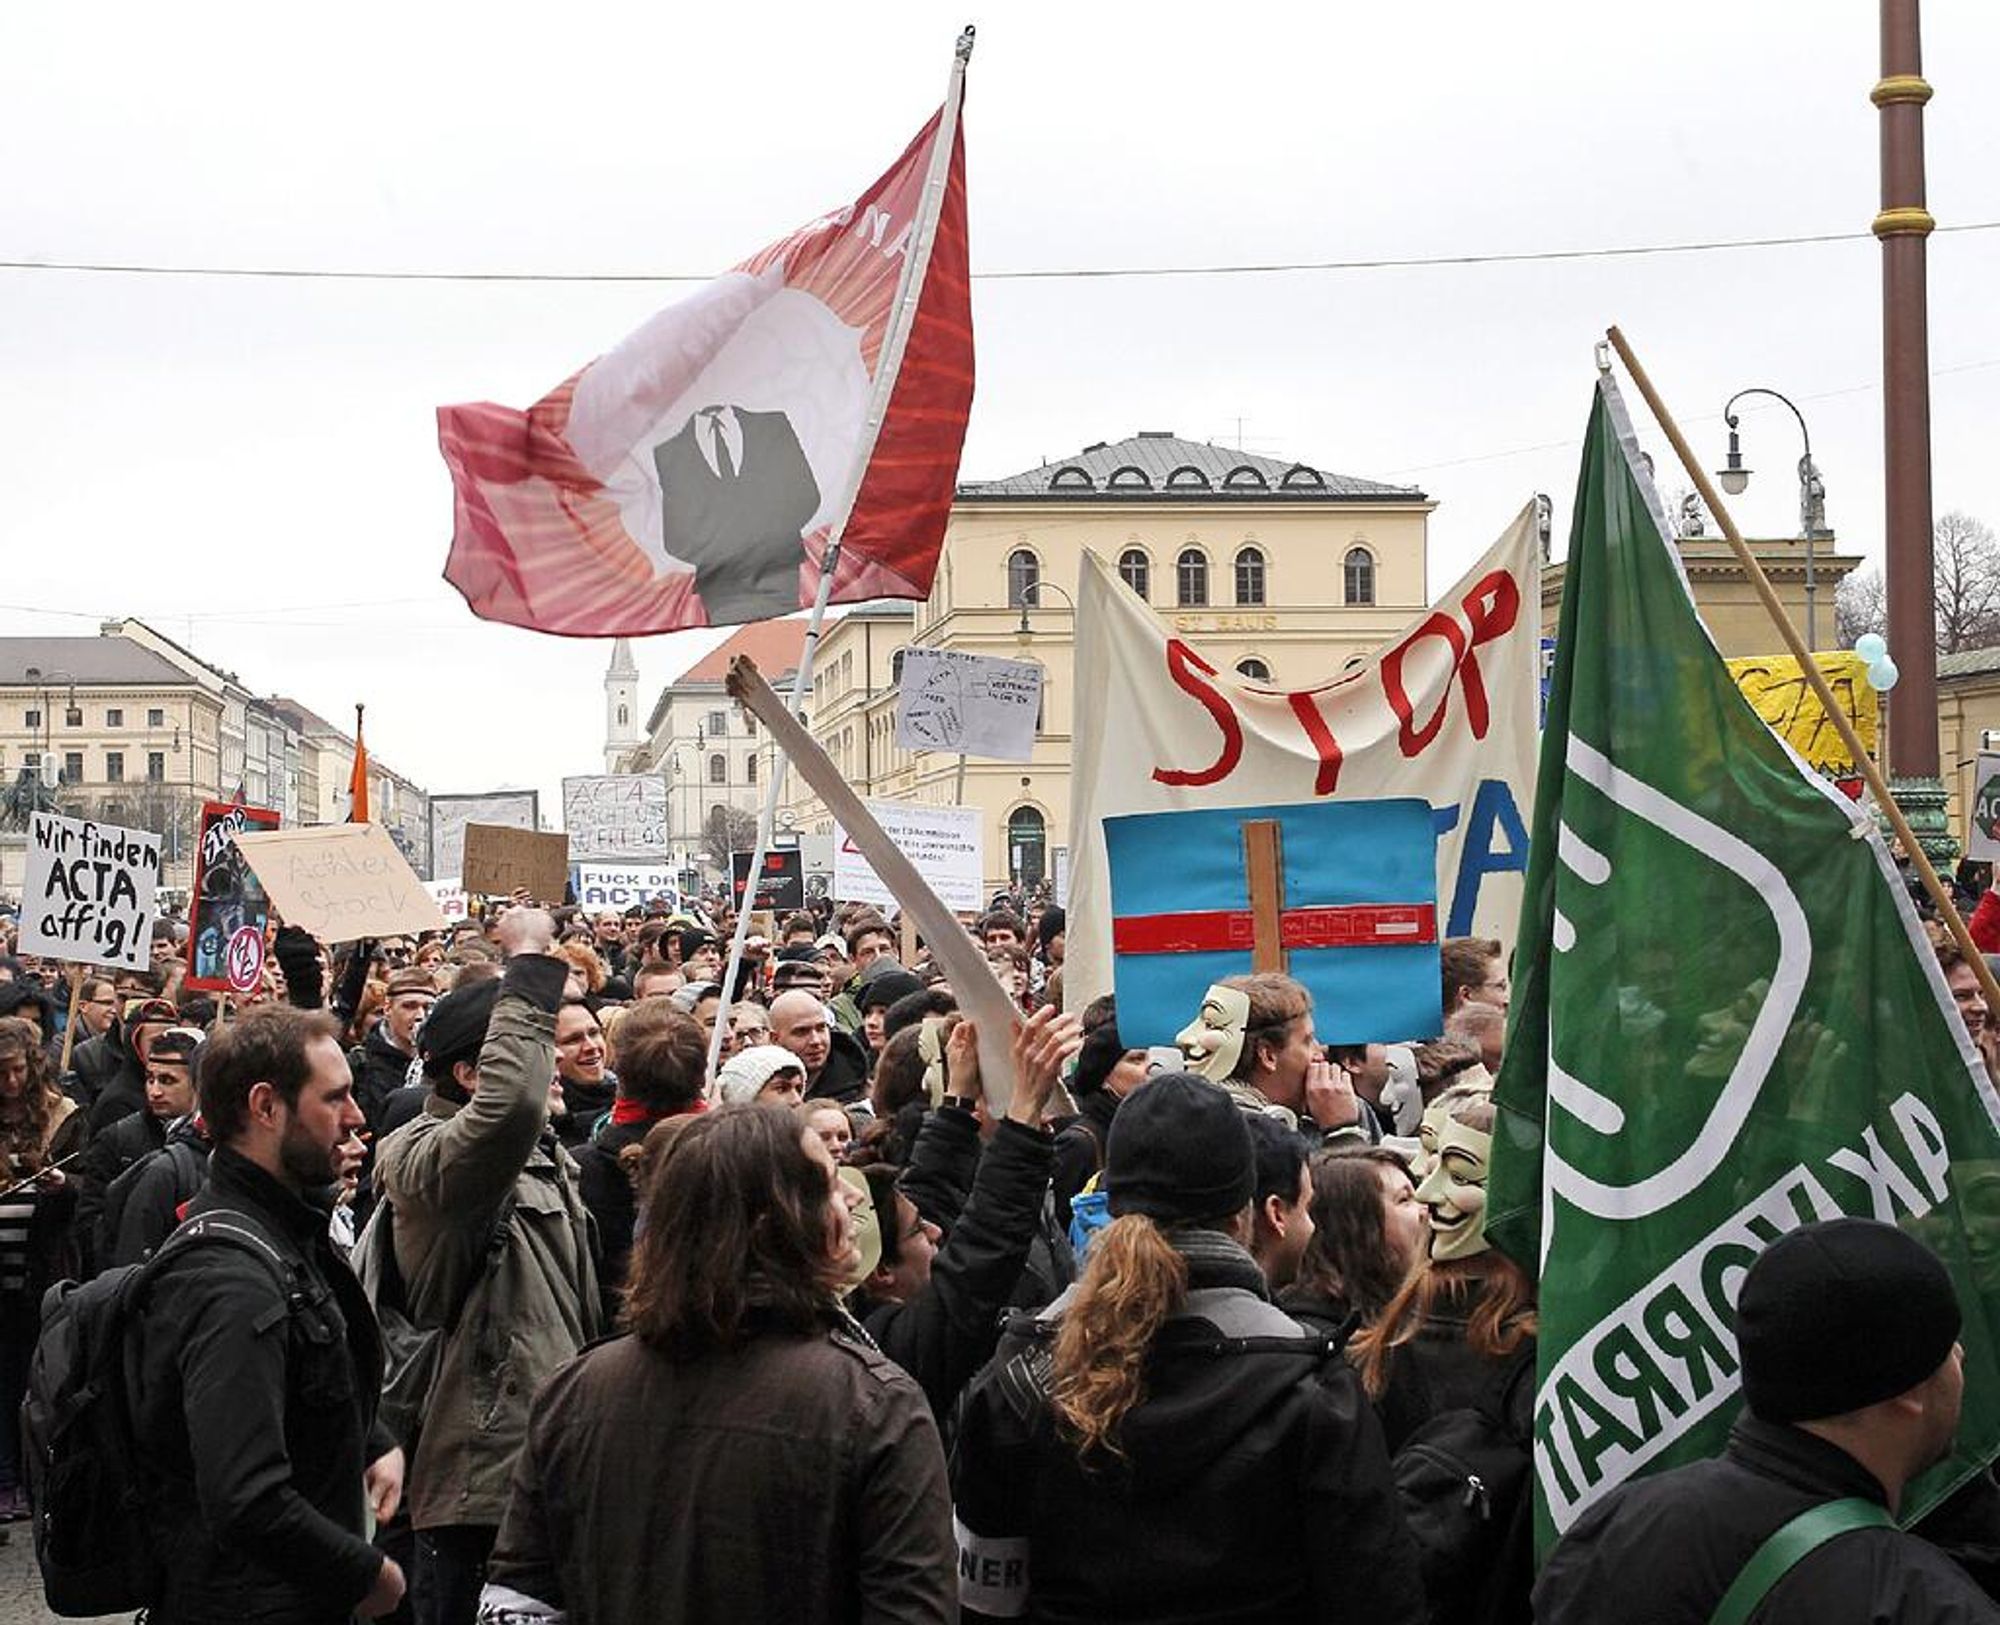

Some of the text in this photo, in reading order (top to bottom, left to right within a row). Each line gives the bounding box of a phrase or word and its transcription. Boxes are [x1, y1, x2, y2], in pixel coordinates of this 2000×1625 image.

[1152, 569, 1521, 796] STOP
[568, 781, 643, 809] ACTA
[35, 818, 158, 870] Wir finden
[203, 808, 245, 866] STOP
[45, 857, 137, 910] ACTA
[584, 872, 676, 886] FUCK DA
[586, 886, 678, 905] ACTA
[40, 902, 145, 962] affig!
